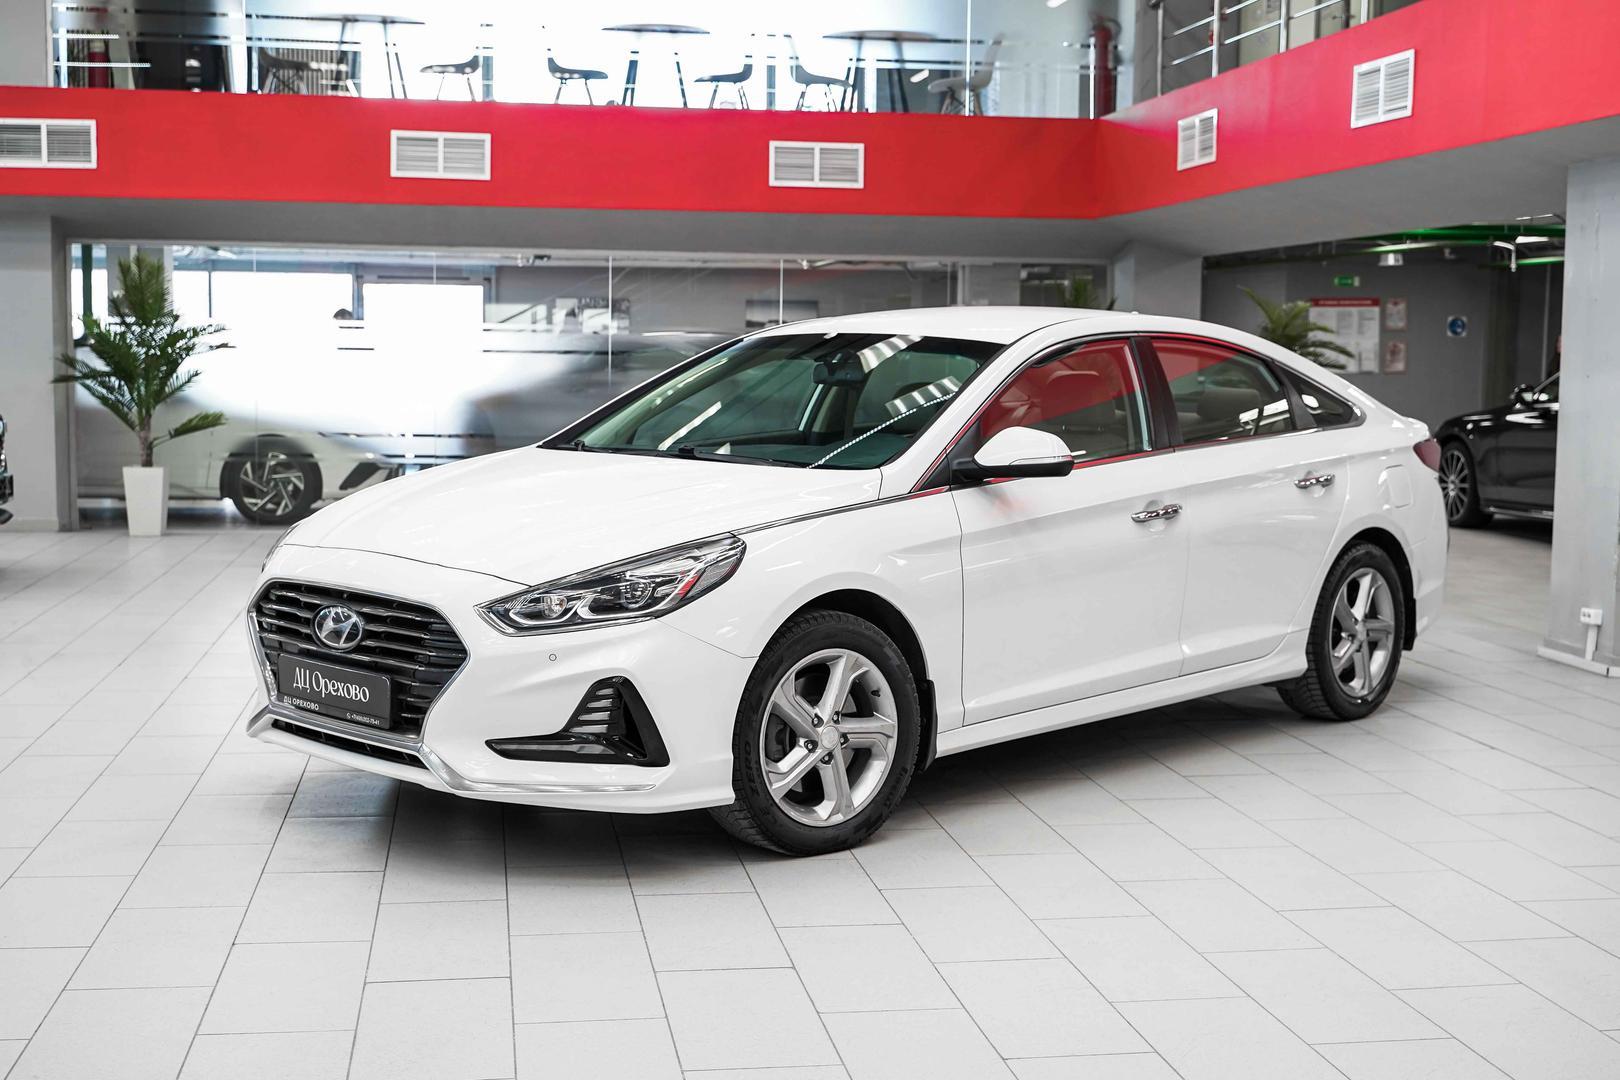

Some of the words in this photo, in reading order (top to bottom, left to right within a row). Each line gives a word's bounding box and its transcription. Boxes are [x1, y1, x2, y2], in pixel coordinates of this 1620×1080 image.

[293, 666, 311, 693] ДЦ
[312, 671, 369, 702] Орехово
[283, 695, 292, 705] ДЦ
[292, 697, 319, 711] ОРЕХОВО
